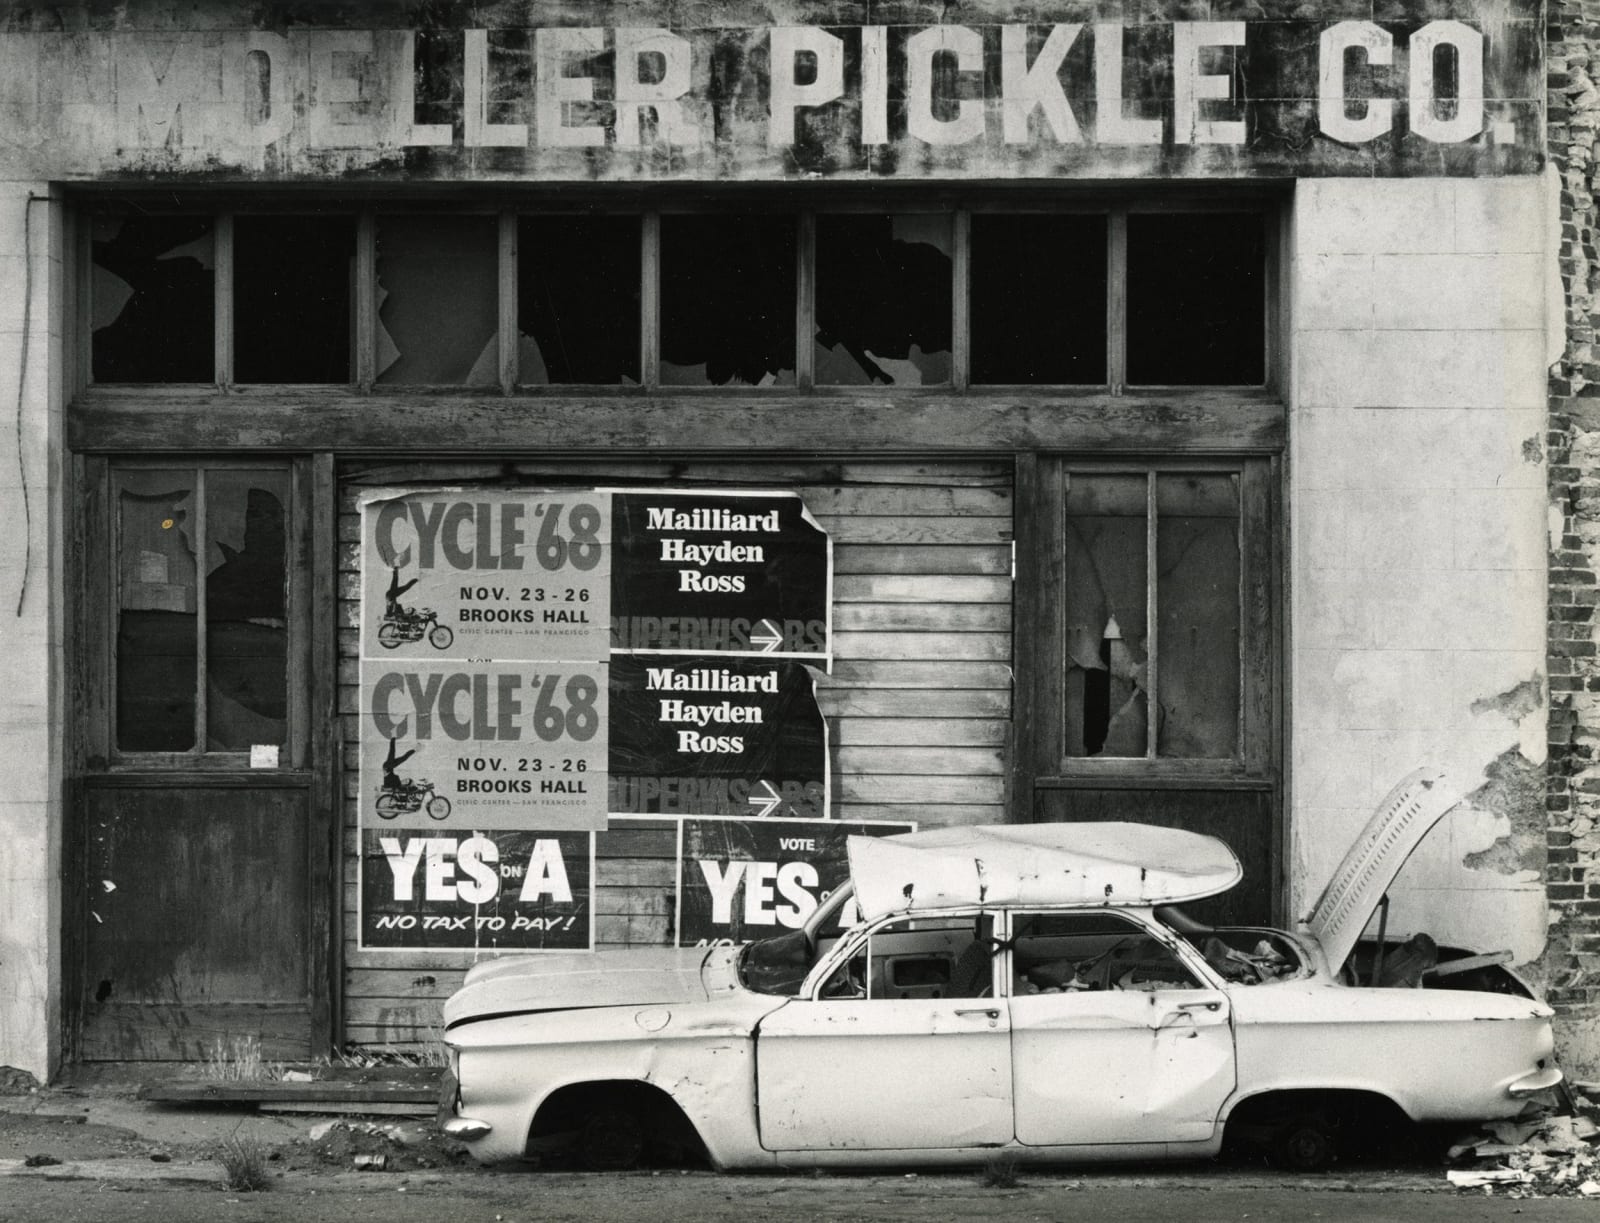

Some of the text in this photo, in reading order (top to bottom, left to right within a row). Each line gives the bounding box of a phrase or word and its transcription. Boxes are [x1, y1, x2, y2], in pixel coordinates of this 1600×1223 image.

[116, 19, 1516, 148] MOELLER PICKLE CO.
[646, 507, 780, 532] Mailliard
[375, 501, 525, 571] CYCLE
[660, 539, 764, 566] Hayden
[460, 587, 510, 601] NOV.
[678, 570, 745, 593] Ross
[459, 608, 590, 623] BROOKS HALL
[646, 668, 779, 693] Mailliard
[371, 672, 522, 741] CYCLE
[659, 699, 763, 726] Hayden
[677, 730, 744, 753] Ross
[457, 758, 507, 772] NOV.
[457, 779, 587, 793] BROOKS HALL
[779, 837, 816, 851] VOTE
[379, 836, 574, 904] YES ON A
[699, 859, 820, 930] YES
[375, 914, 416, 930] NO
[422, 915, 472, 930] TAX
[476, 915, 505, 931] TO
